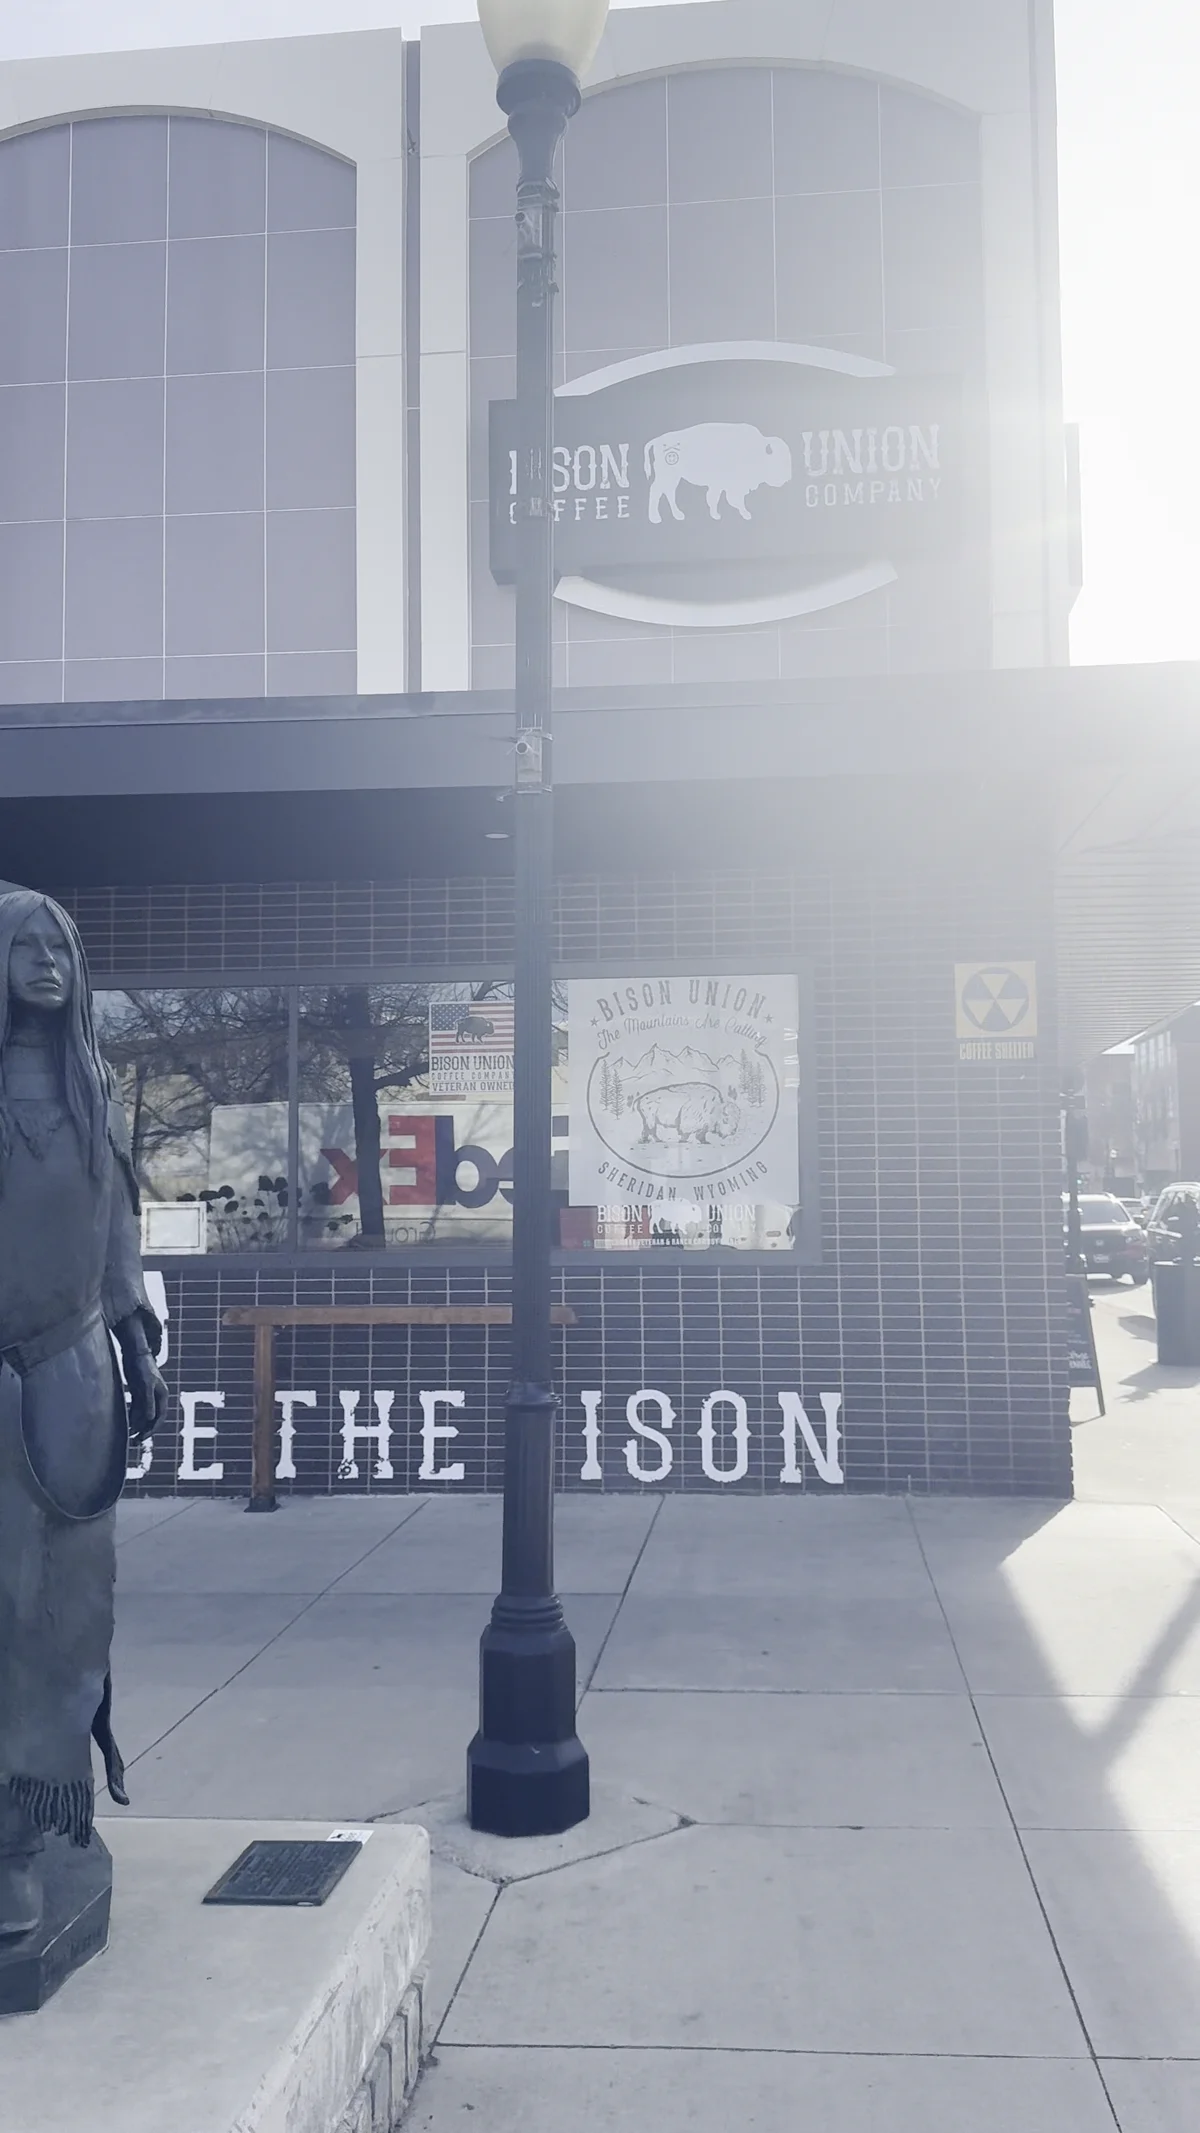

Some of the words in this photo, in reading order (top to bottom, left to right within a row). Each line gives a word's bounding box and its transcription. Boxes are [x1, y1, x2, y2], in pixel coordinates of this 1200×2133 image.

[508, 443, 630, 494] SON
[801, 422, 940, 477] UNION
[508, 496, 631, 525] CFFEE
[806, 477, 941, 507] COMPANY
[596, 979, 672, 1022] BISON
[689, 979, 767, 1019] UNION
[597, 1028, 621, 1050] The
[624, 1014, 689, 1035] Mountains
[695, 1012, 720, 1030] Are
[431, 1056, 470, 1071] BISON
[473, 1055, 514, 1070] UNION
[960, 1042, 992, 1060] COFFEE
[995, 1041, 1035, 1059] SHELTER
[431, 1071, 465, 1081] COFFEE
[471, 1070, 514, 1080] COMPAN
[432, 1082, 476, 1092] VETERAN
[693, 1160, 768, 1201] WYOMING
[597, 1204, 642, 1222] BISON
[274, 1390, 466, 1481] THE
[580, 1389, 844, 1483] ISON
